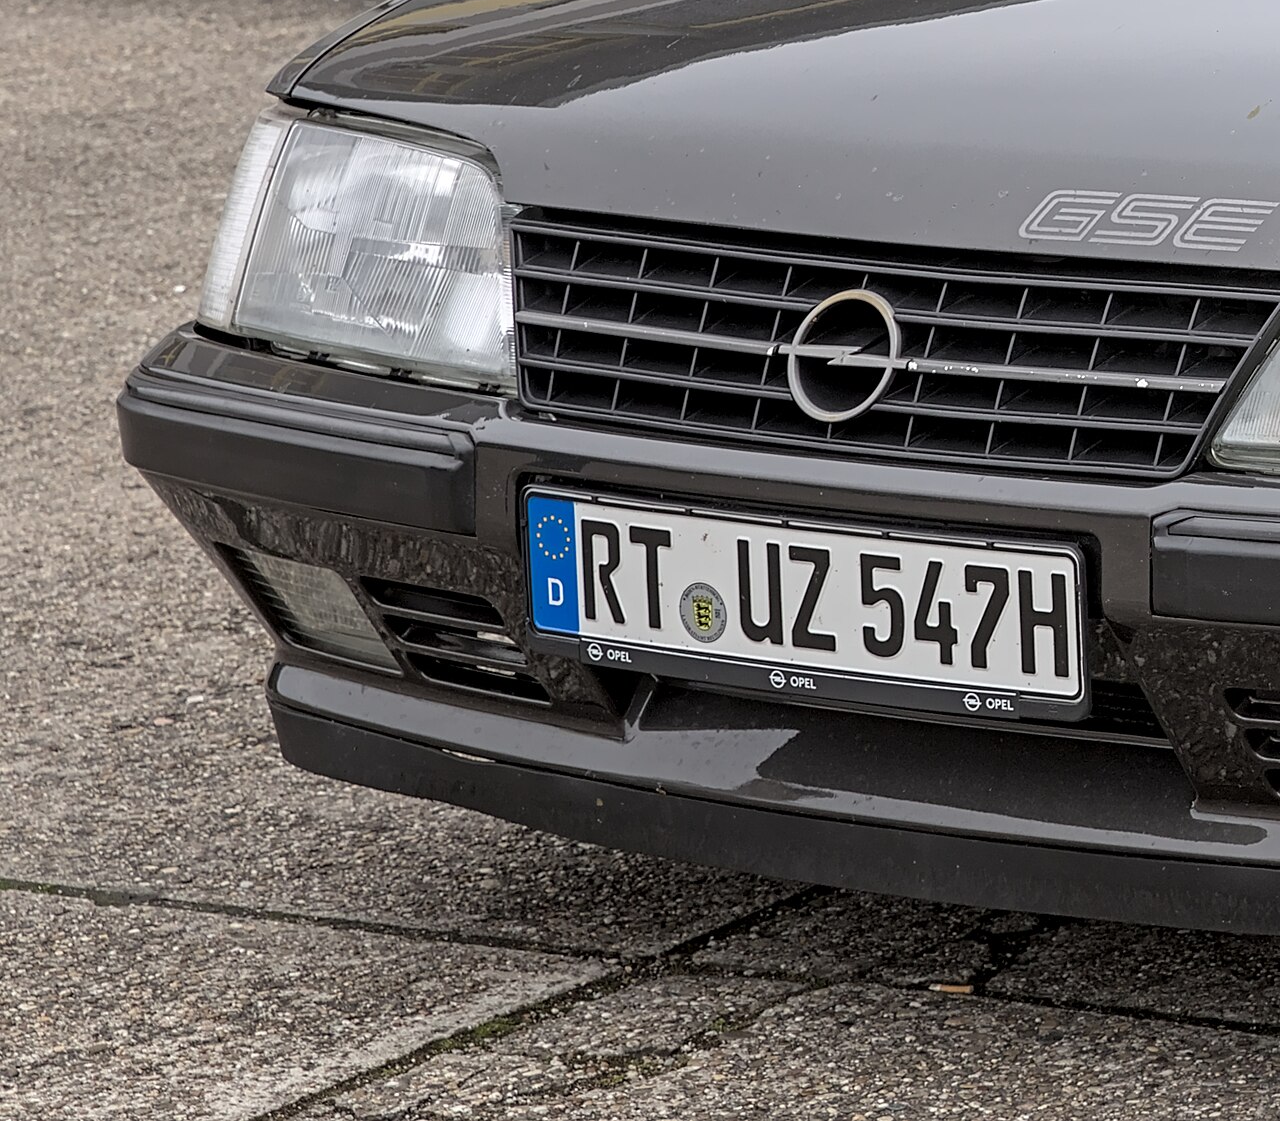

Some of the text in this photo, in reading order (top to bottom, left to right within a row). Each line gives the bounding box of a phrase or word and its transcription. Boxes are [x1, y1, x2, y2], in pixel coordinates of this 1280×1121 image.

[1018, 189, 1280, 252] GSE
[547, 577, 564, 607] D
[580, 518, 672, 630] RT
[736, 537, 837, 653] UZ
[858, 552, 1070, 678] 547H
[606, 649, 632, 663] OPEL
[790, 675, 817, 690] OPEL
[985, 697, 1014, 711] OPEL
